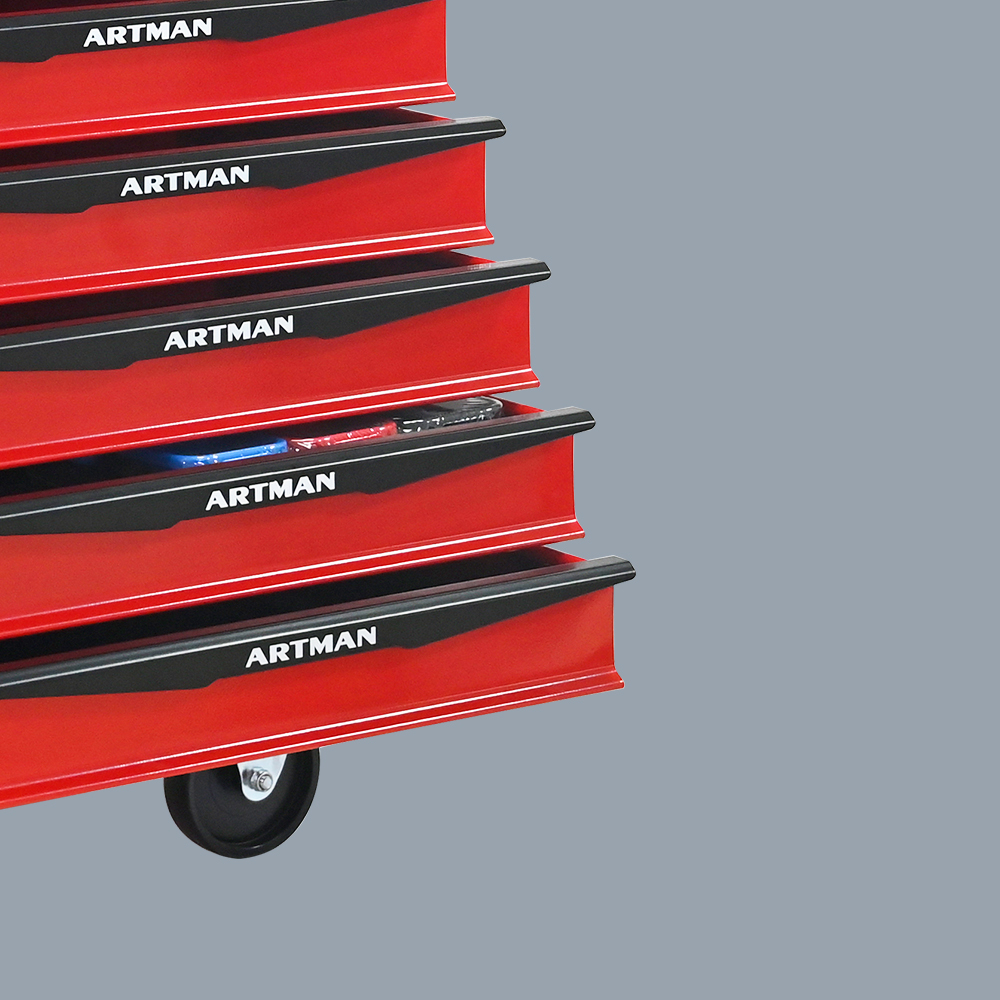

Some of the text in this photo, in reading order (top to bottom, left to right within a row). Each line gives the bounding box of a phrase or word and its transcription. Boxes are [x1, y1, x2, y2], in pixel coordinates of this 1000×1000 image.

[83, 17, 213, 48] ARTMAN
[120, 164, 250, 197] ARTMAN
[163, 314, 294, 352] ARTMAN
[205, 471, 336, 511] ARTMAN
[245, 625, 377, 669] ARTMAN
